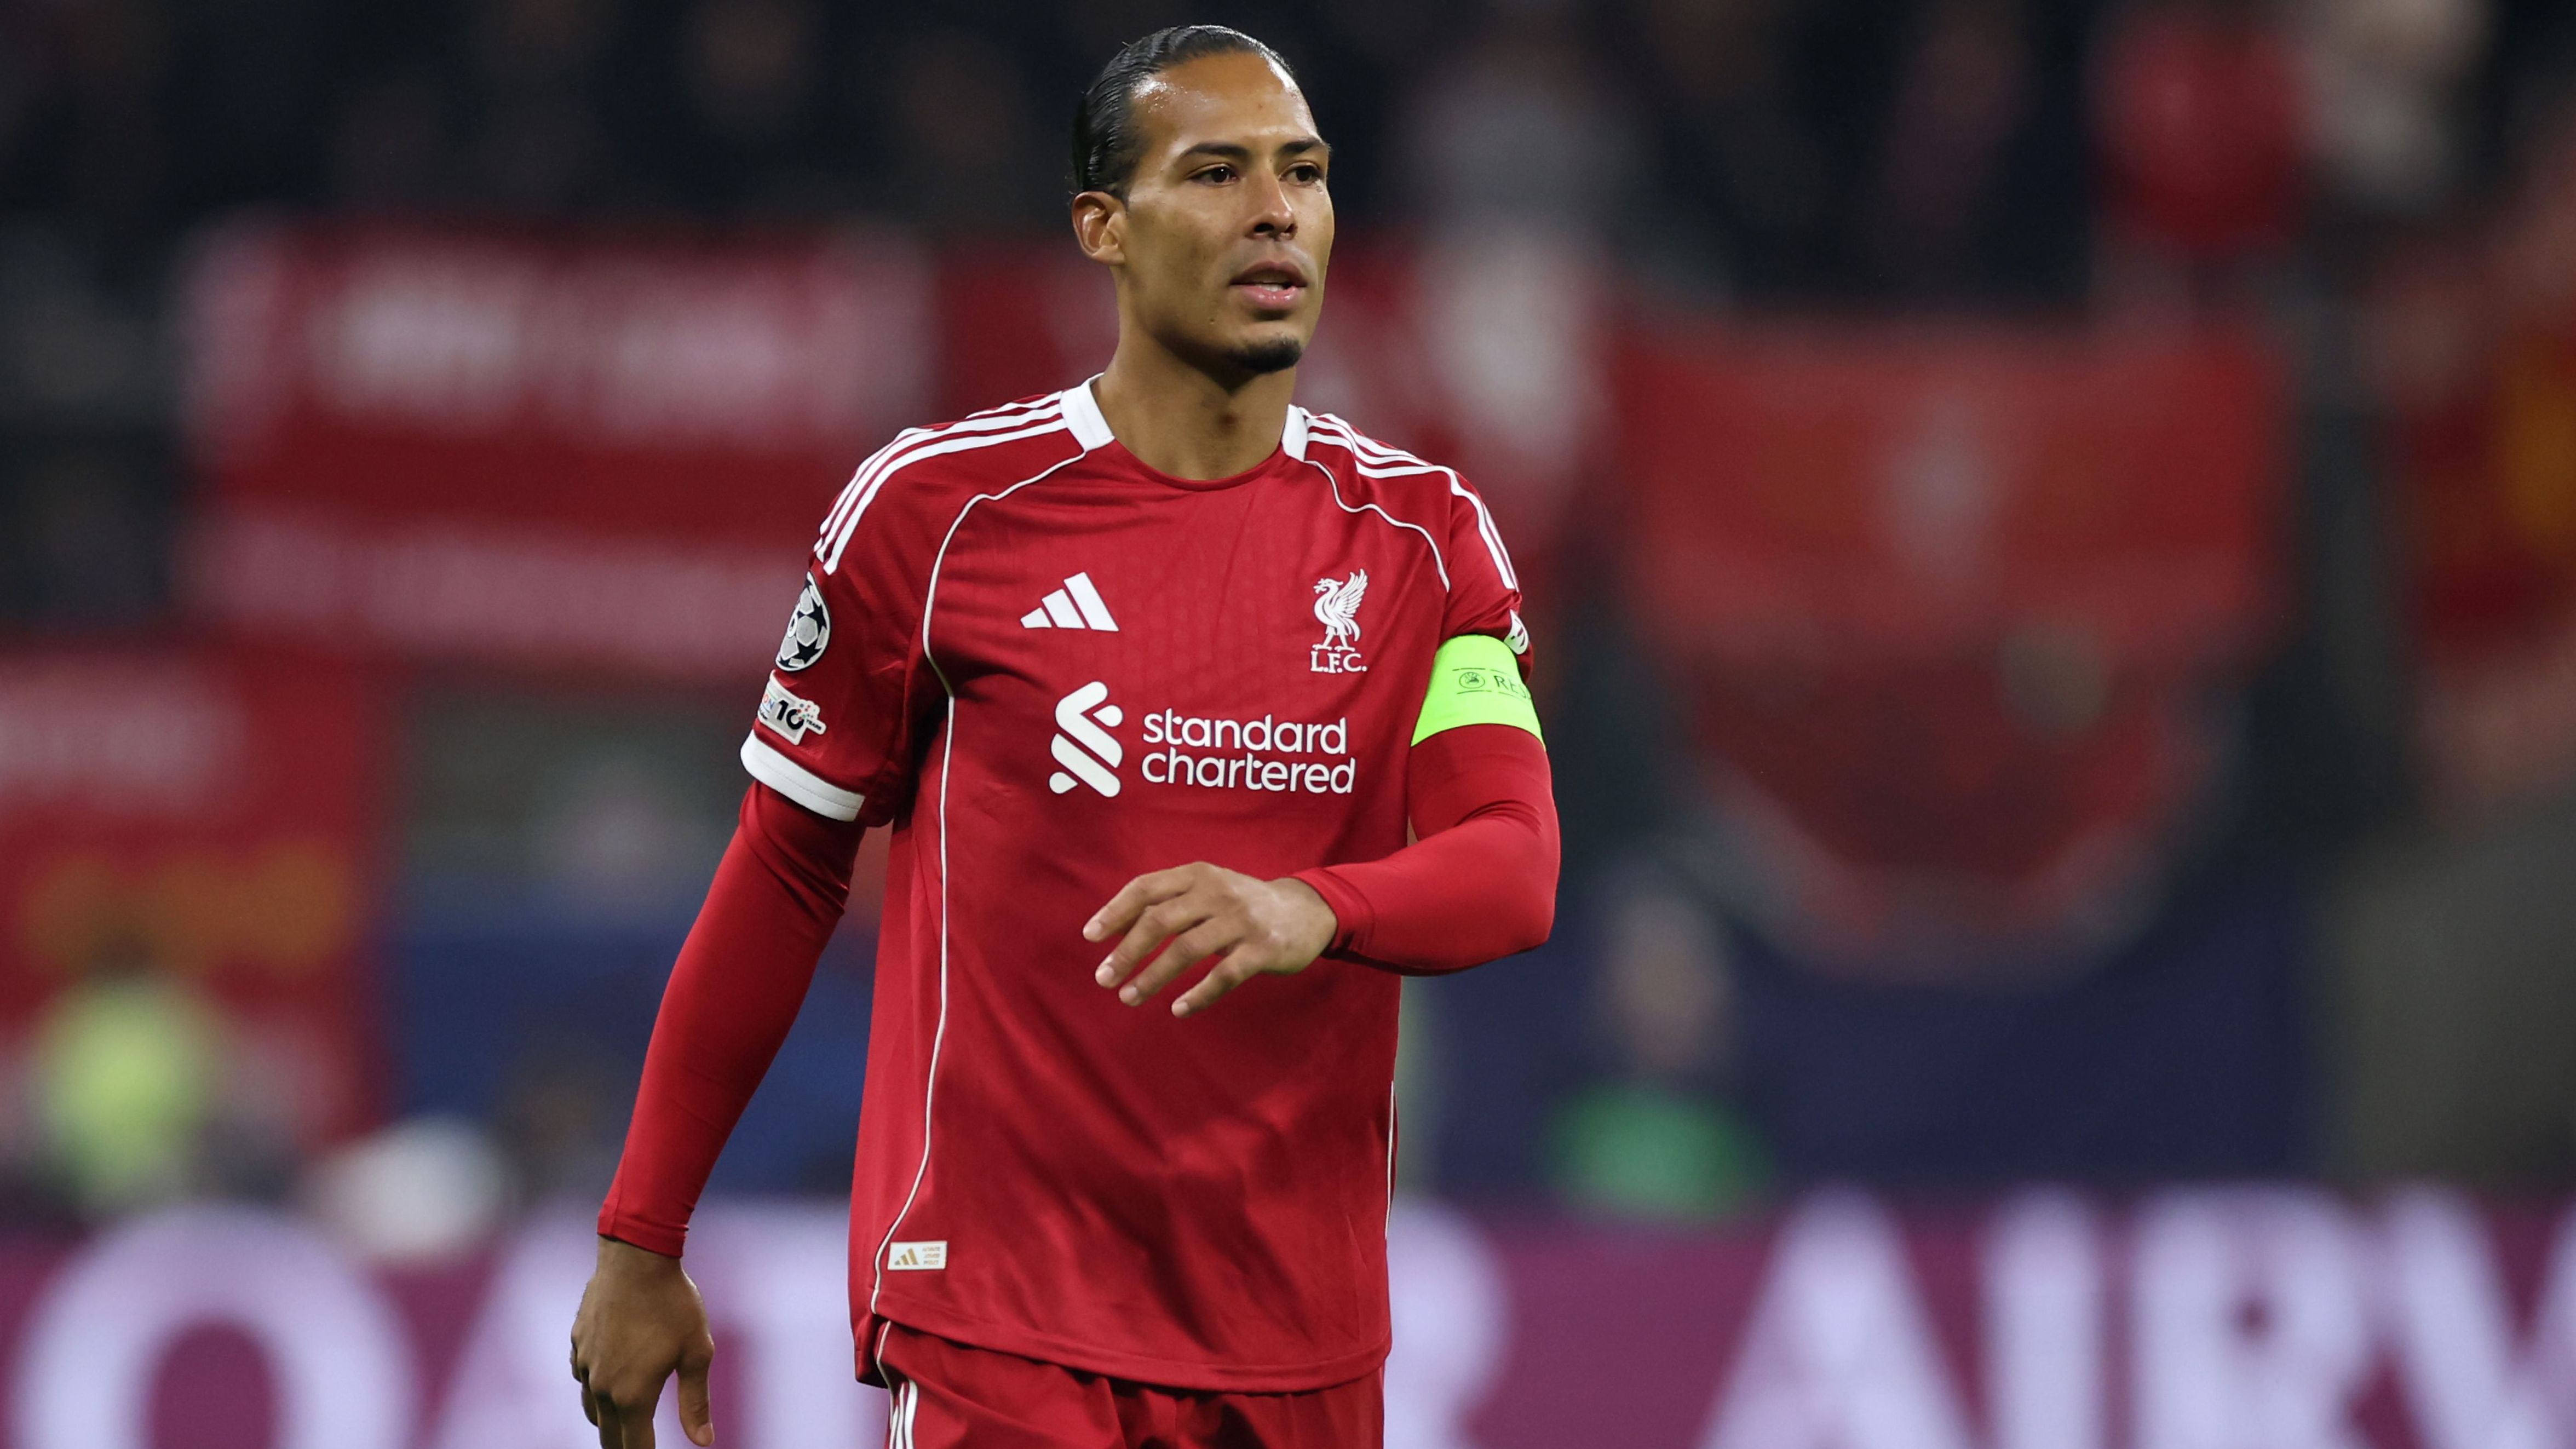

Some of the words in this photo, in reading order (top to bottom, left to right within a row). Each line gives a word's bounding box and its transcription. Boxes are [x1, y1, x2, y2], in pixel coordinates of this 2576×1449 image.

[1310, 651, 1367, 674] L.F.C.
[777, 700, 804, 730] 10
[1143, 708, 1346, 755] standard
[1142, 746, 1355, 794] chartered
